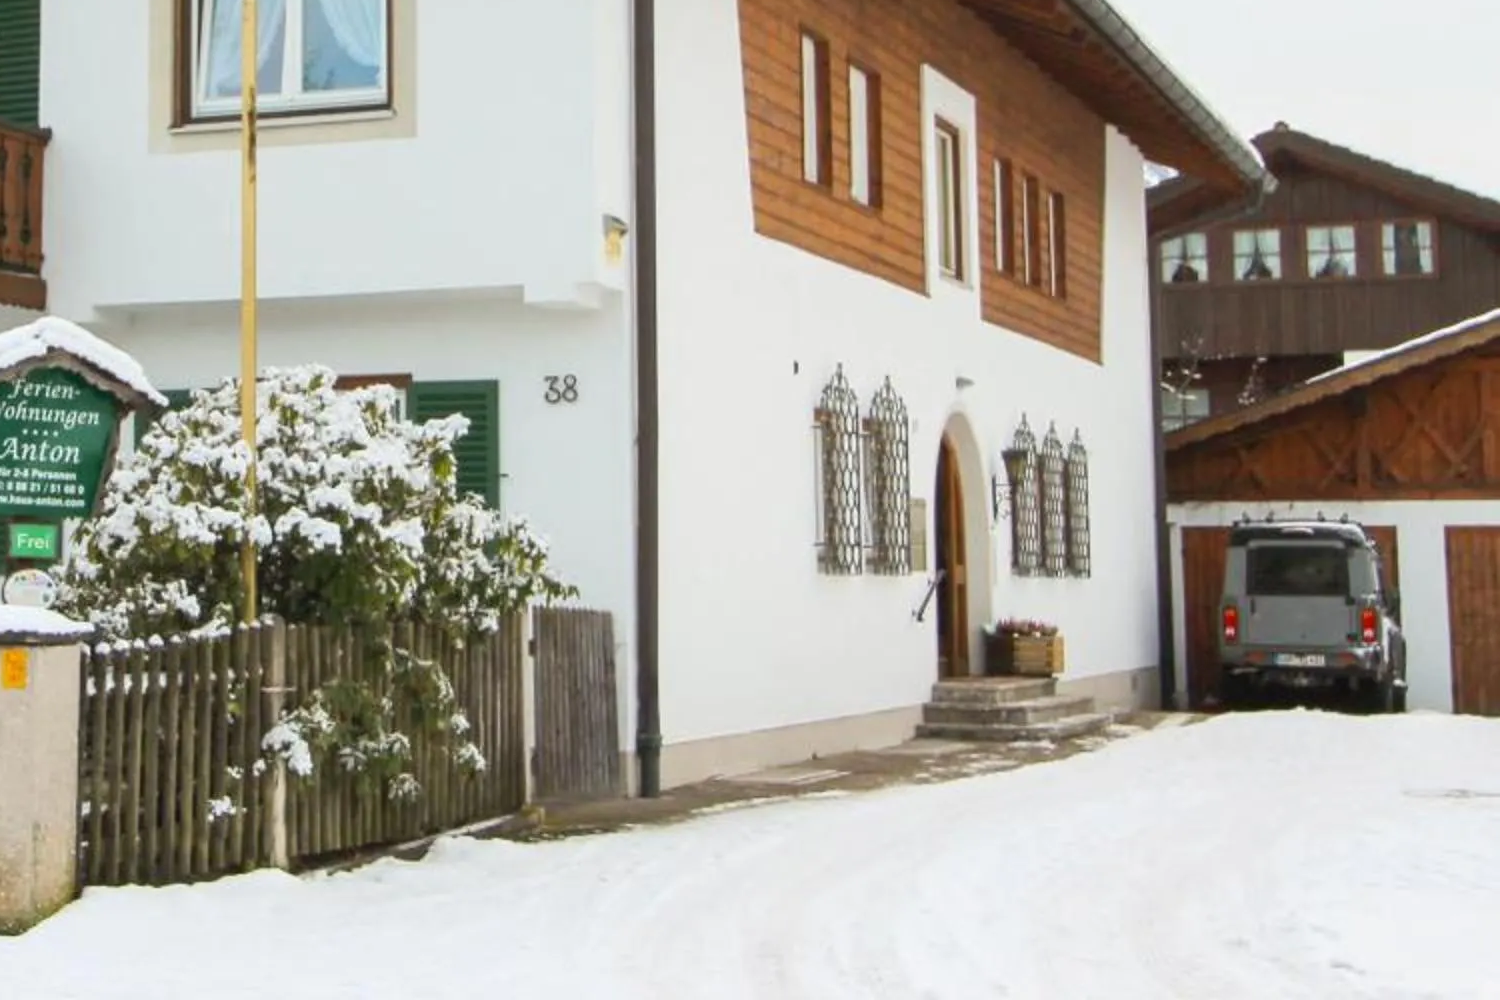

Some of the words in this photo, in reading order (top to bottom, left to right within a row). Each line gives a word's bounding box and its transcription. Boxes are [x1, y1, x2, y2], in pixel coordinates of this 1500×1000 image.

[7, 378, 81, 400] Ferien-
[544, 373, 578, 404] 38
[31, 468, 77, 480] Personen
[17, 533, 50, 549] Frei
